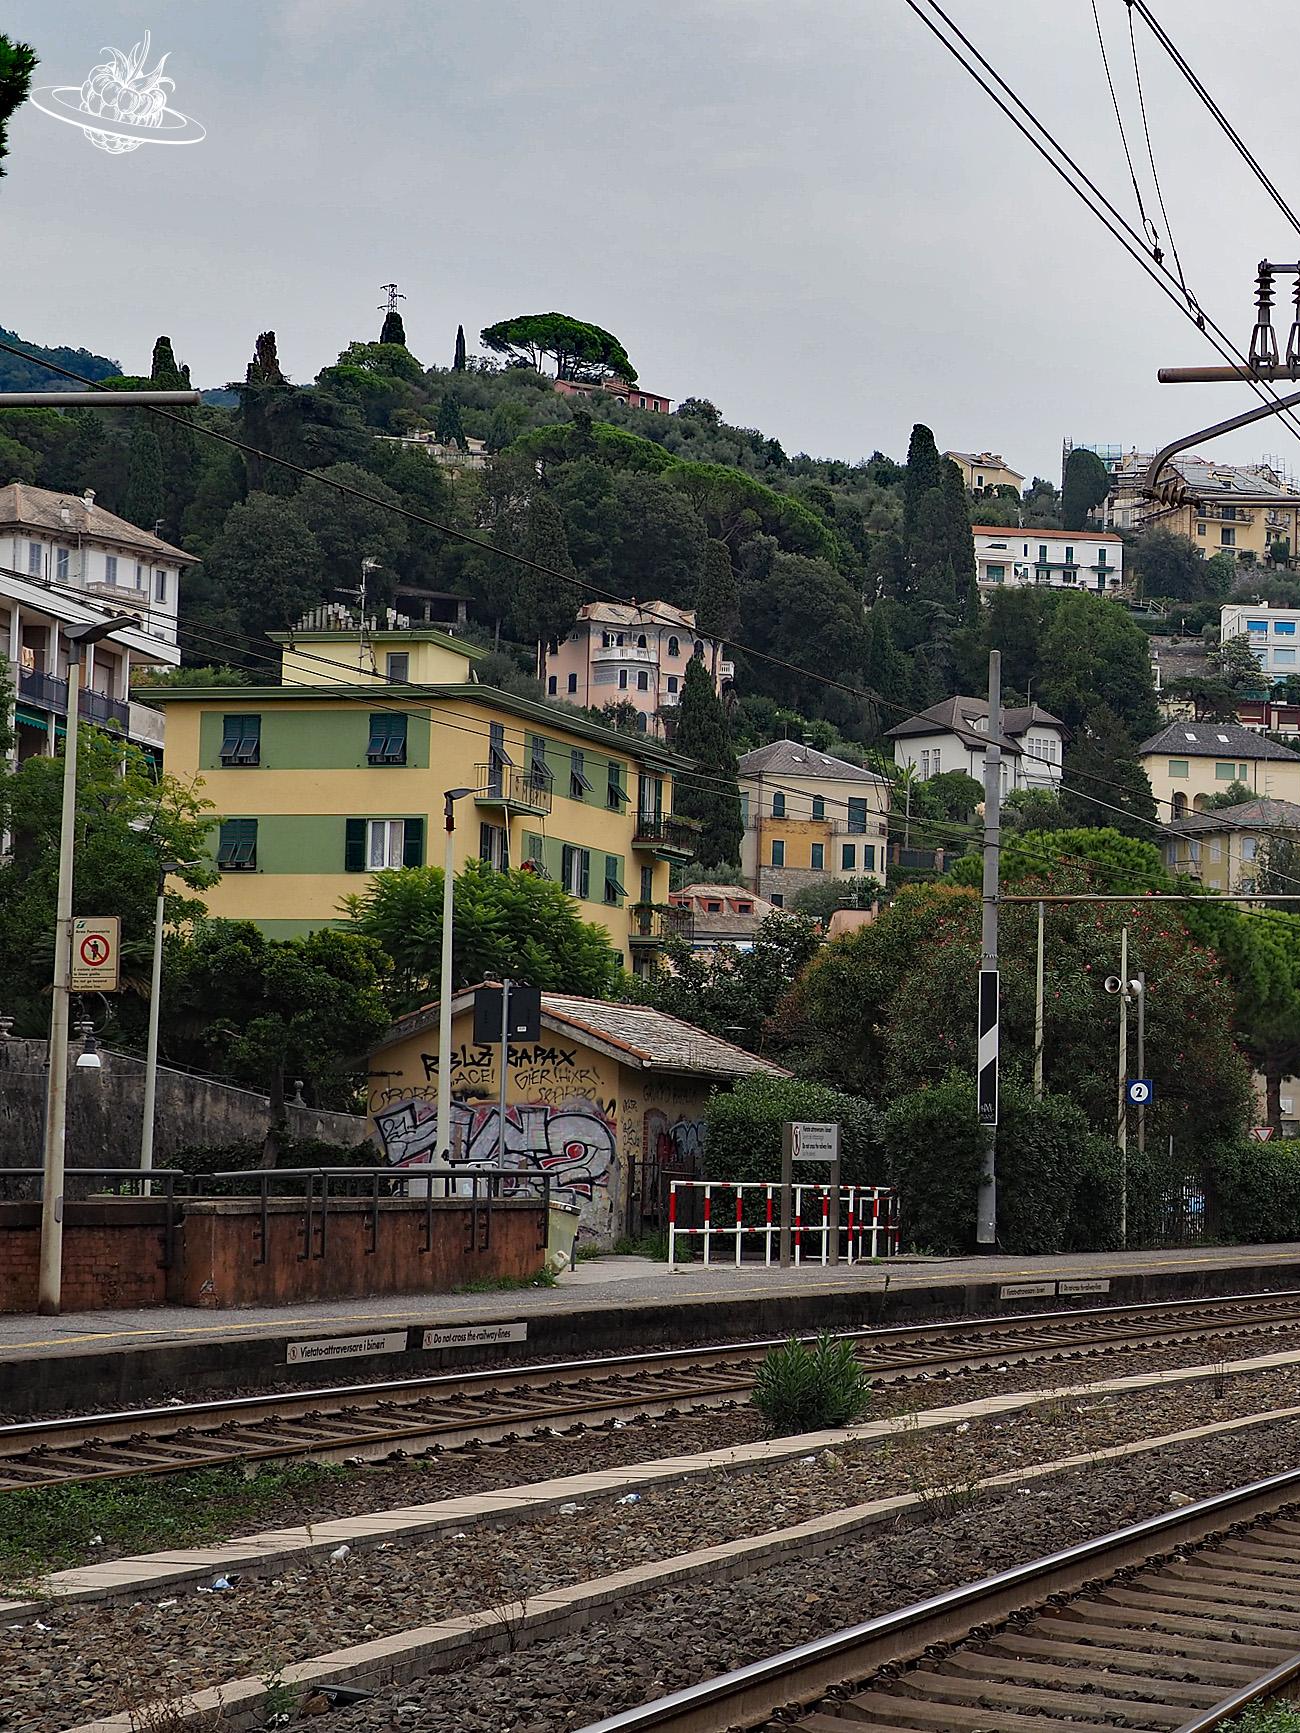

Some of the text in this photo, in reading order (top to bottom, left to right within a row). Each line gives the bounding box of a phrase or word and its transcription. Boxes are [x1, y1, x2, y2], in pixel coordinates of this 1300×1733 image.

[1135, 1086, 1143, 1098] 2
[433, 1333, 441, 1344] Do
[442, 1332, 452, 1343] not
[452, 1332, 467, 1342] cross
[467, 1330, 476, 1341] the
[476, 1329, 498, 1341] railway
[300, 1345, 323, 1358] Vietato
[323, 1343, 363, 1356] attraversare
